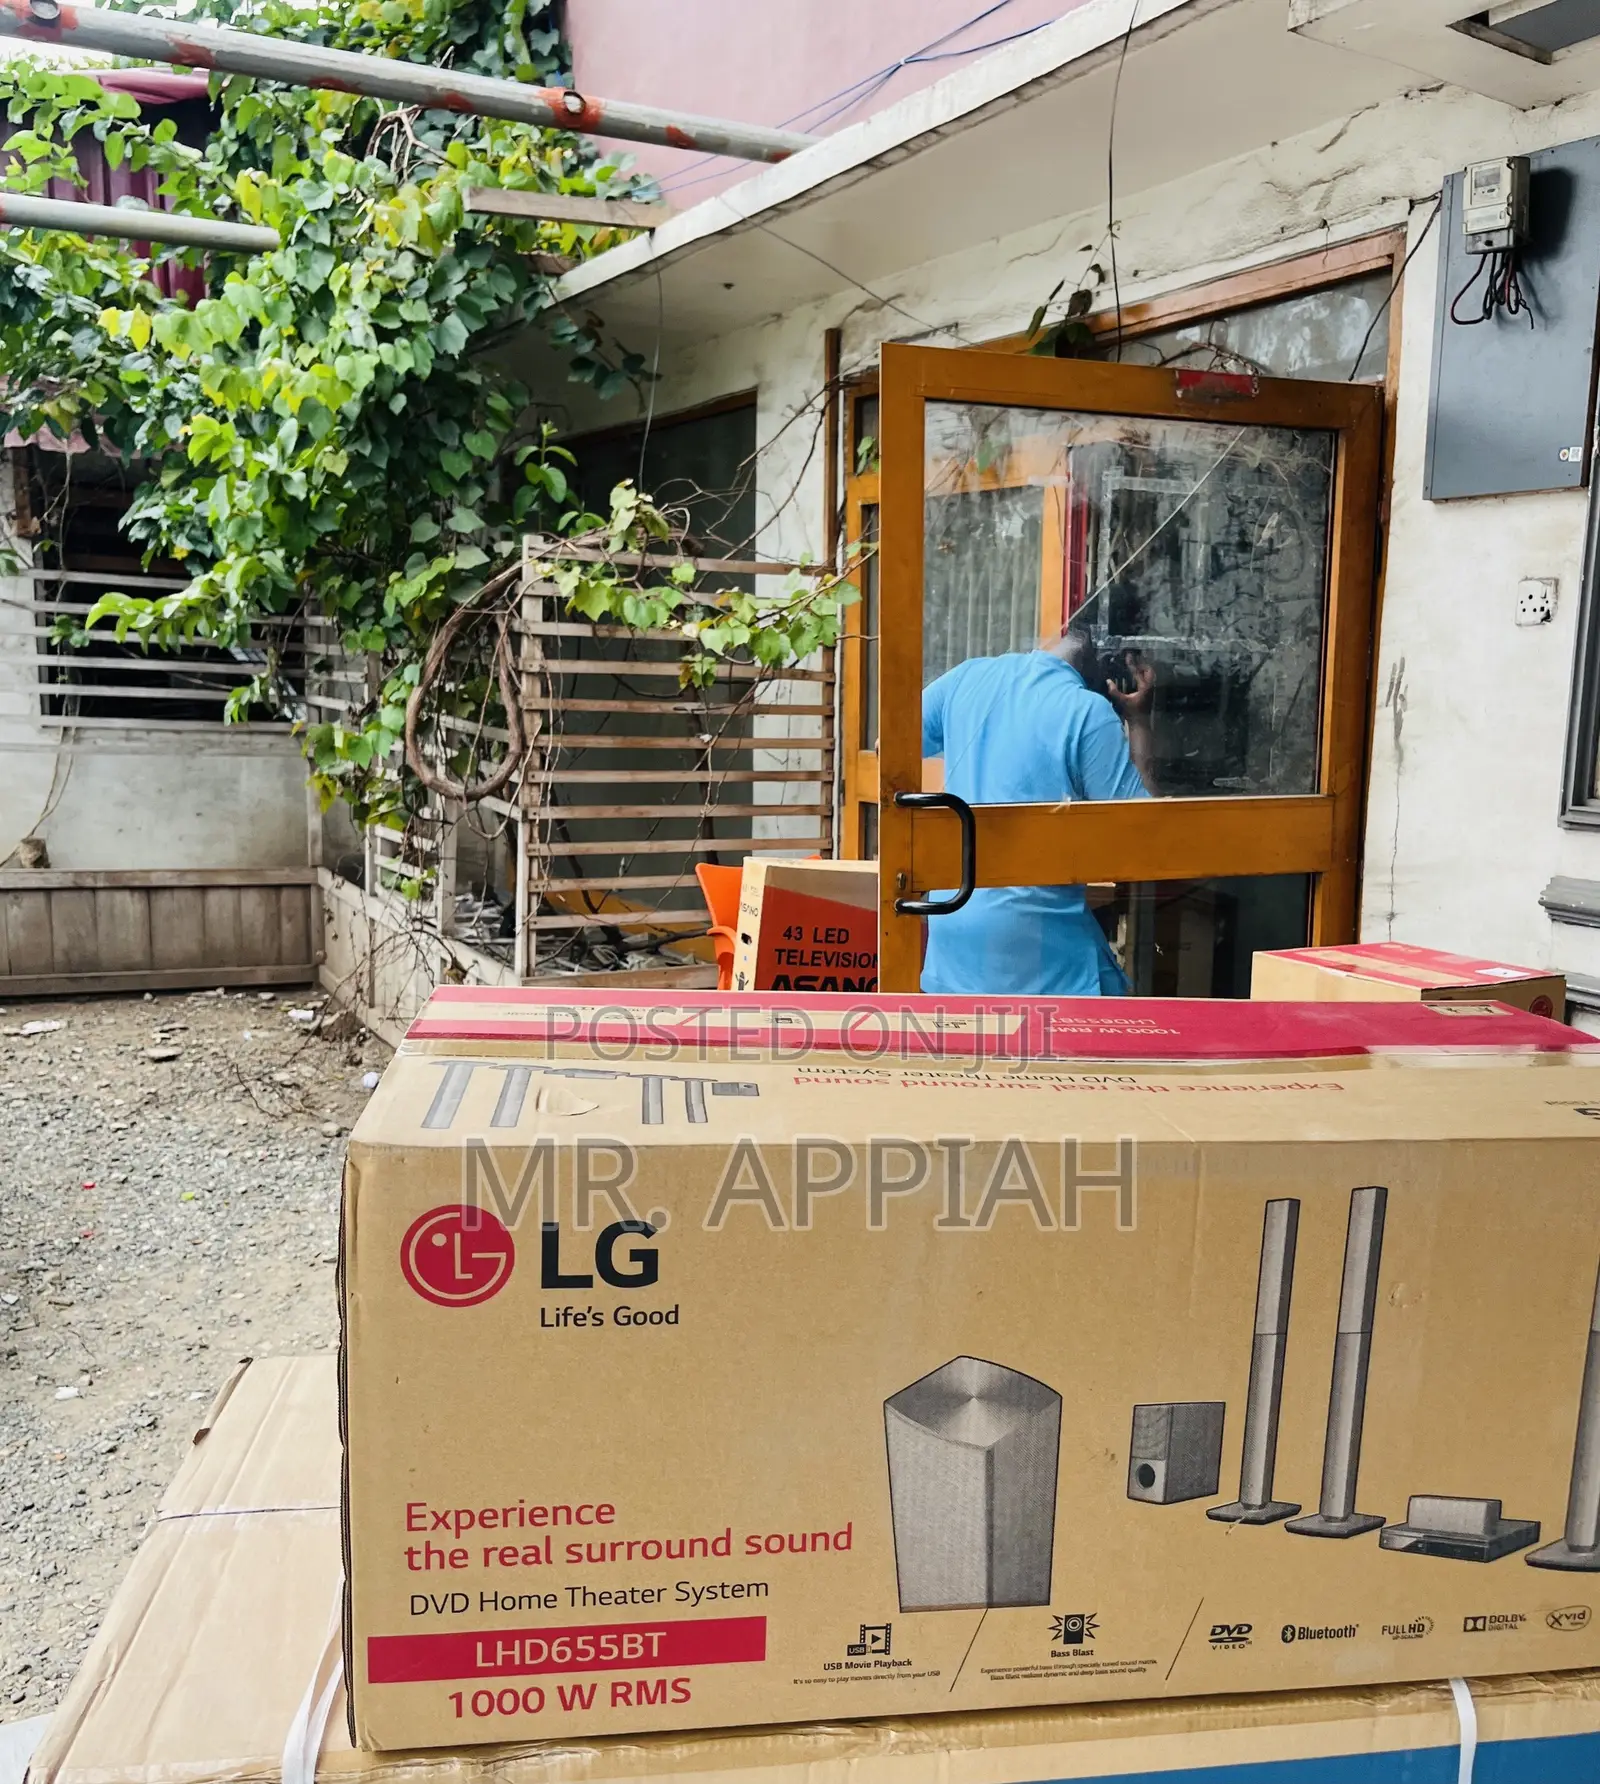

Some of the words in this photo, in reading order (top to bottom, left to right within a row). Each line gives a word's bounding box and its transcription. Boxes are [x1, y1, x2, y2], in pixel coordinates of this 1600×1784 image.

[783, 926, 803, 941] 43
[813, 927, 850, 945] LED
[797, 1067, 892, 1077] System
[902, 1071, 997, 1081] Theater
[793, 1076, 890, 1085] sound
[1002, 1074, 1075, 1082] Home
[1081, 1076, 1137, 1084] DVD
[900, 1079, 1042, 1090] surround
[1048, 1083, 1109, 1092] real
[1120, 1085, 1170, 1093] the
[1178, 1082, 1345, 1092] Experience
[540, 1220, 660, 1290] LG
[540, 1304, 605, 1328] Life's
[612, 1304, 680, 1327] Good
[406, 1500, 616, 1538] Experience
[404, 1544, 470, 1572] the
[482, 1536, 552, 1568] real
[565, 1527, 732, 1565] surround
[745, 1522, 853, 1555] sound
[410, 1592, 470, 1617] DVD
[479, 1589, 558, 1612] Home
[564, 1585, 668, 1609] Theater
[675, 1580, 770, 1606] System
[1489, 1614, 1524, 1624] DOLBY
[1210, 1623, 1253, 1637] DVD
[1298, 1625, 1357, 1640] Bluetooth
[1381, 1624, 1406, 1636] FULL
[1408, 1623, 1425, 1634] HD
[1488, 1623, 1519, 1631] DIGITAL
[475, 1631, 668, 1668] LHD655BT
[848, 1645, 866, 1654] USB
[1050, 1650, 1070, 1658] Bass
[1072, 1648, 1094, 1657] Blast
[823, 1662, 842, 1671] USB
[845, 1661, 872, 1670] Movie
[874, 1659, 912, 1670] Playback
[448, 1684, 546, 1719] 1000
[556, 1682, 598, 1712] W
[610, 1677, 692, 1708] RMS
